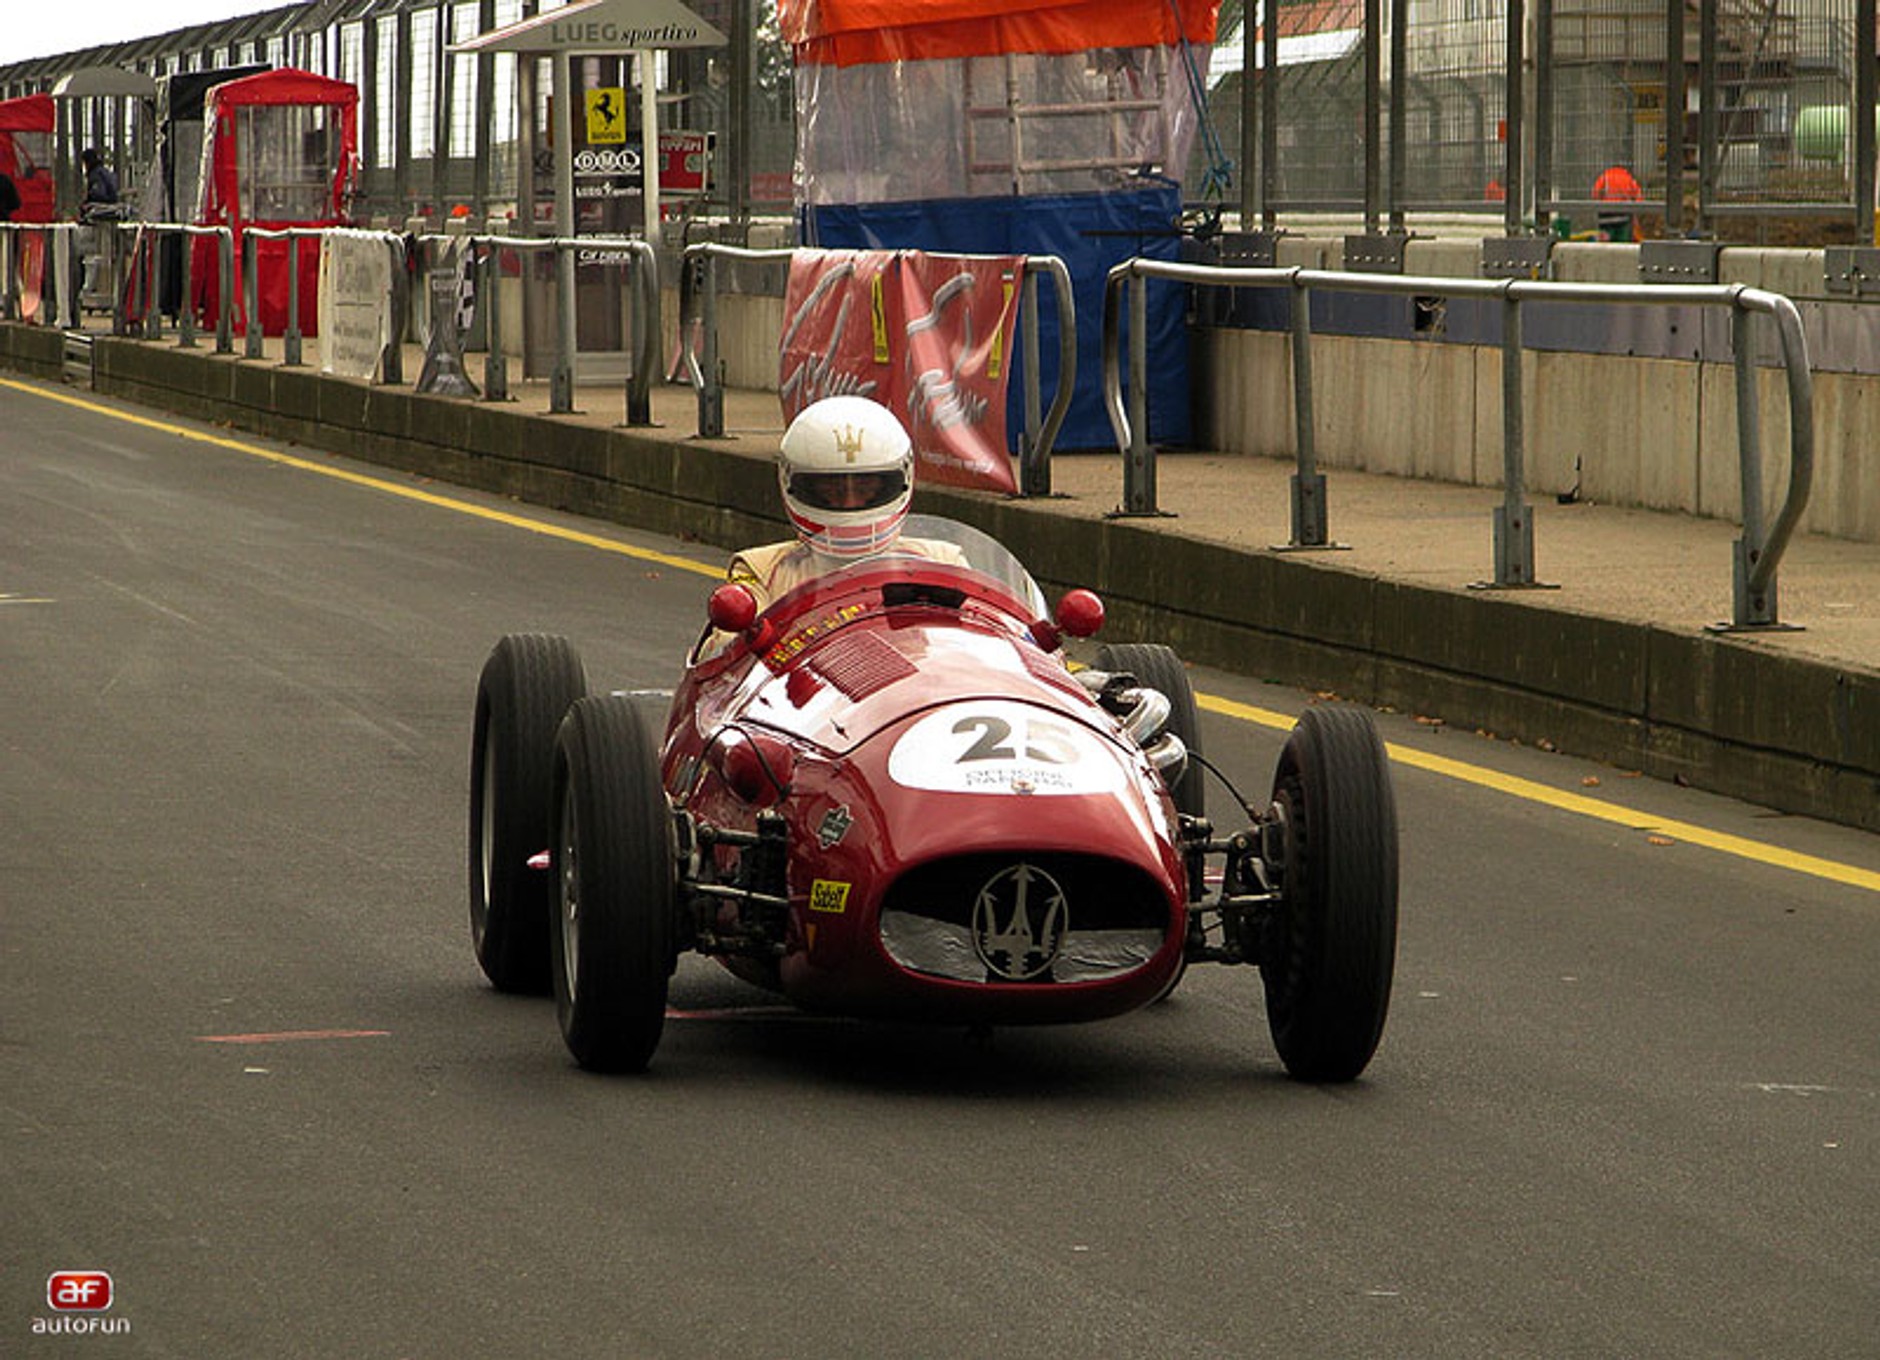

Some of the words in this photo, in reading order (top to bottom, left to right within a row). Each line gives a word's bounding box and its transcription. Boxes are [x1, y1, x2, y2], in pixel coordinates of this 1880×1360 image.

[552, 23, 617, 43] LUEG
[620, 22, 697, 48] sportivo
[952, 716, 1081, 765] 25
